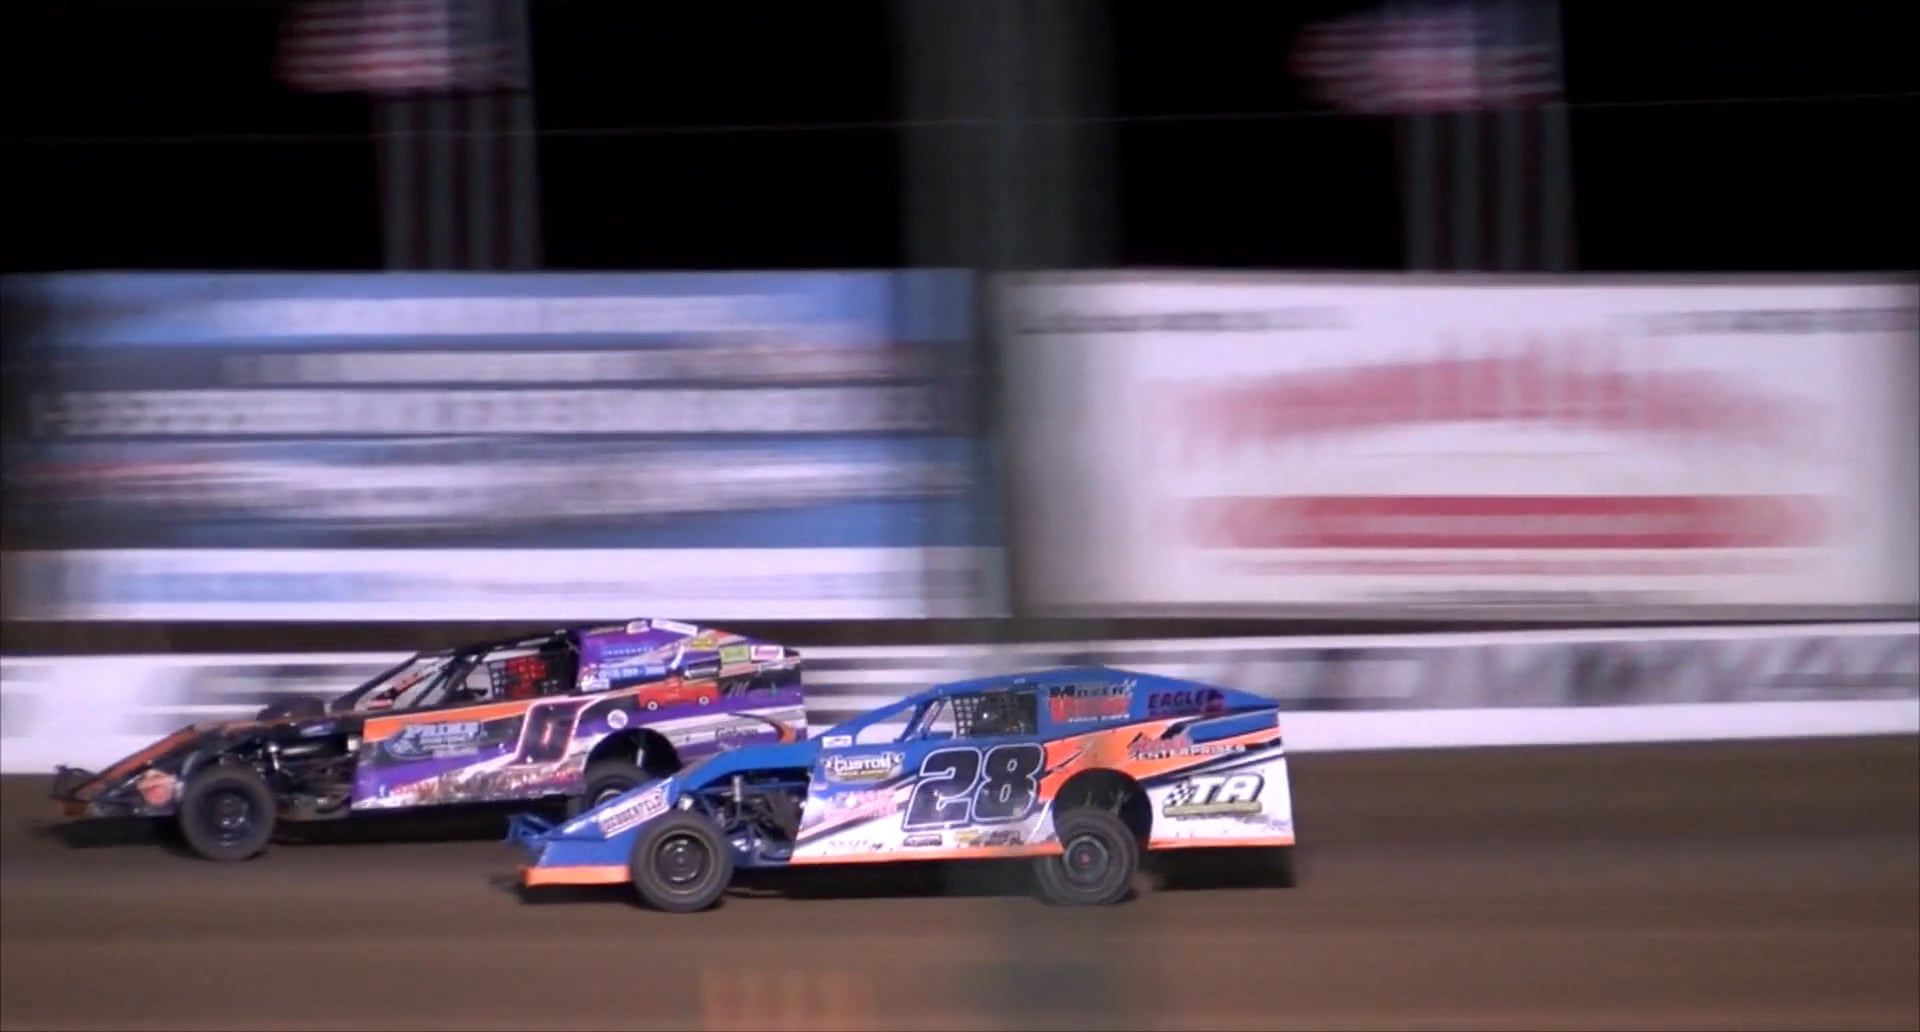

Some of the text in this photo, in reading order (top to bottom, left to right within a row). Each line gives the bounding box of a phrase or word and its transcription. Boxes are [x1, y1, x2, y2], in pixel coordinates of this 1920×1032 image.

[1147, 688, 1206, 710] EAGLE
[833, 755, 893, 772] CUSTOM
[901, 742, 1046, 832] 28
[1188, 773, 1265, 804] TA
